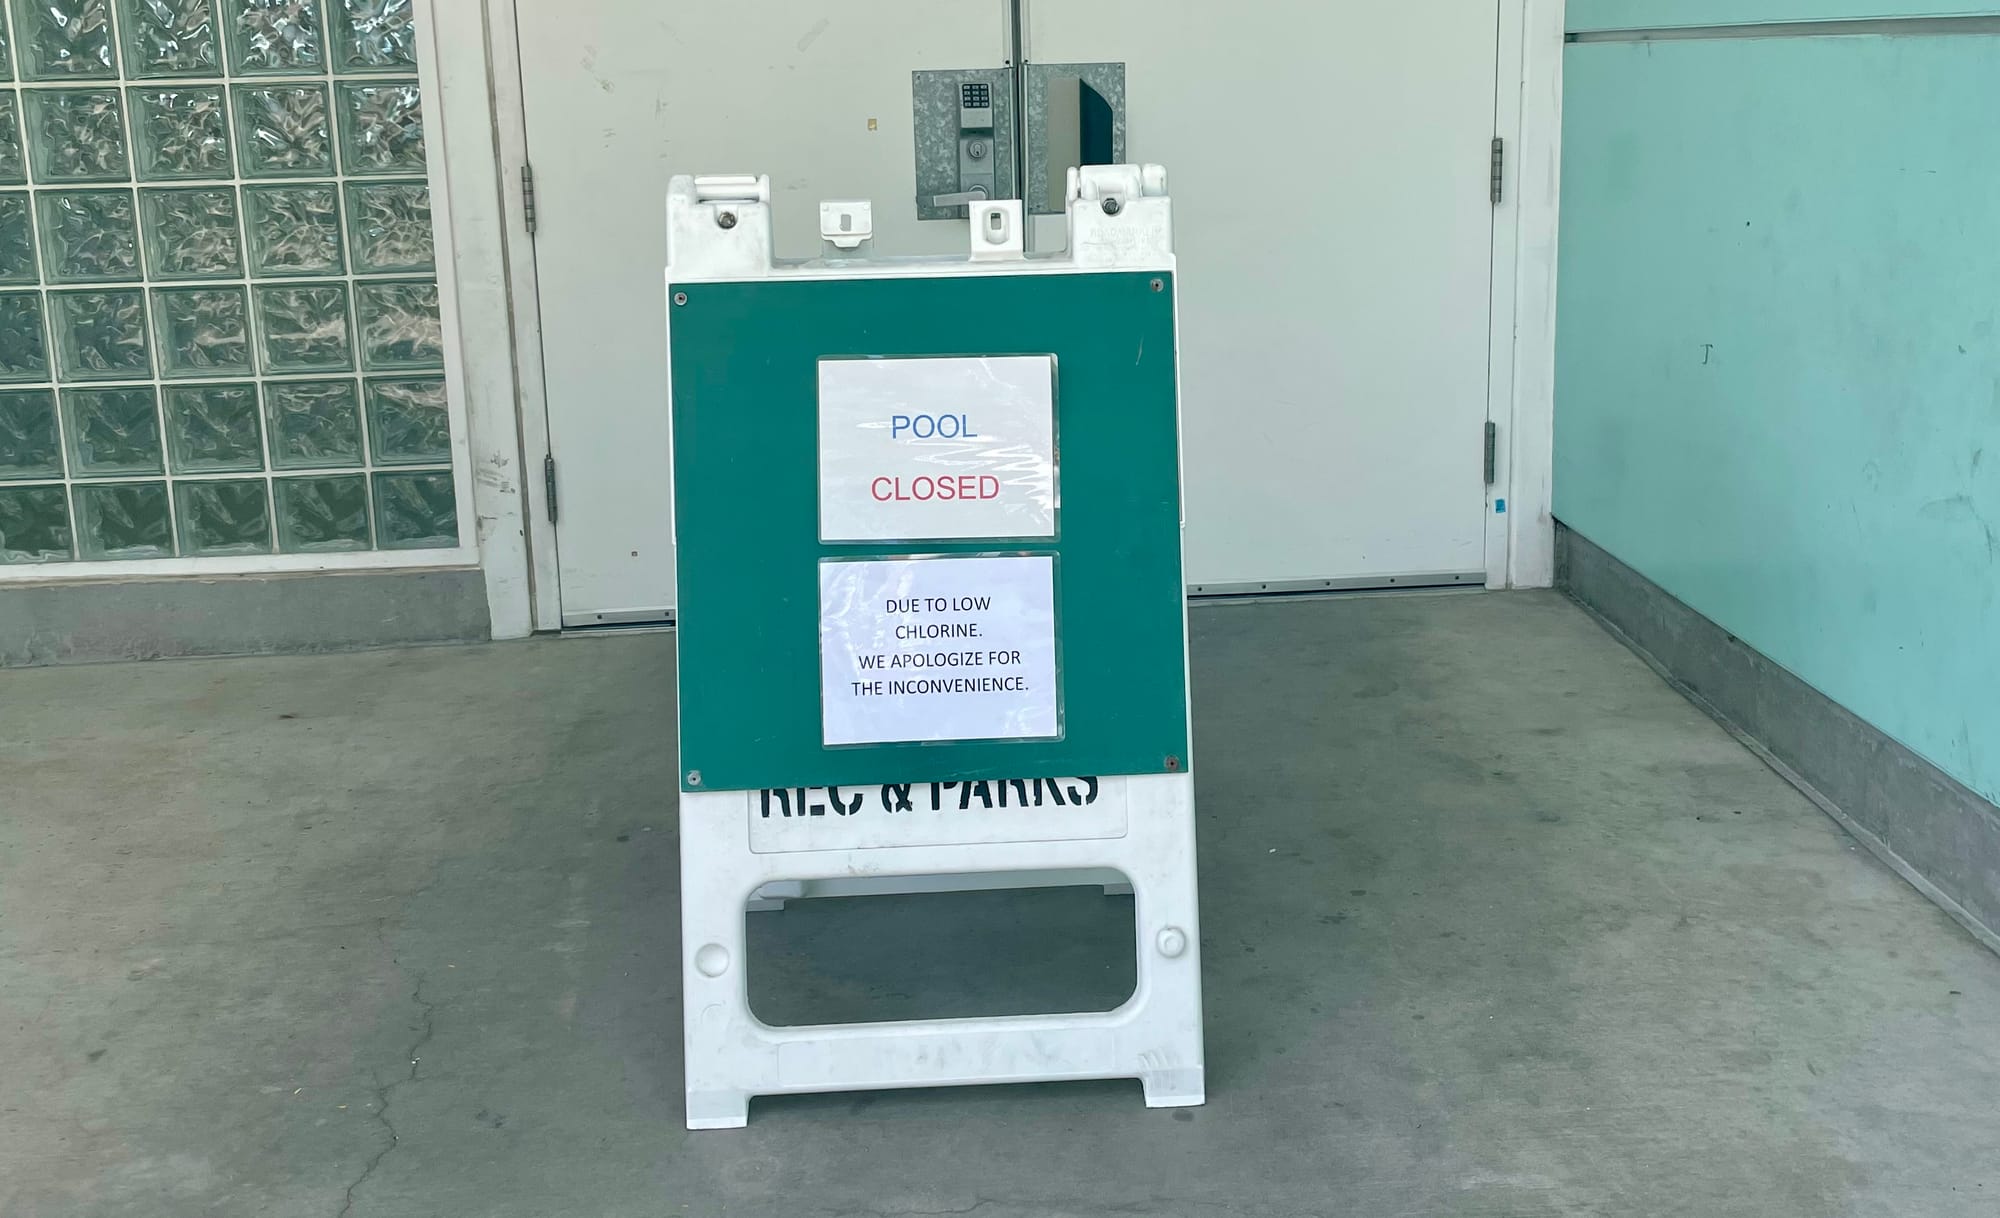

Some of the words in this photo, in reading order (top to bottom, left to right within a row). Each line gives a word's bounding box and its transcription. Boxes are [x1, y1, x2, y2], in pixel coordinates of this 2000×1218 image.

[892, 414, 977, 439] POOL
[871, 476, 999, 501] CLOSED
[886, 599, 919, 613] DUE
[924, 598, 947, 612] TO
[952, 597, 991, 611] LOW
[895, 624, 982, 639] CHLORINE.
[859, 655, 885, 669] WE
[891, 652, 983, 668] APOLOGIZE
[989, 650, 1021, 665] FOR
[852, 682, 882, 696] THE
[888, 677, 1029, 695] INCONVENIENCE.
